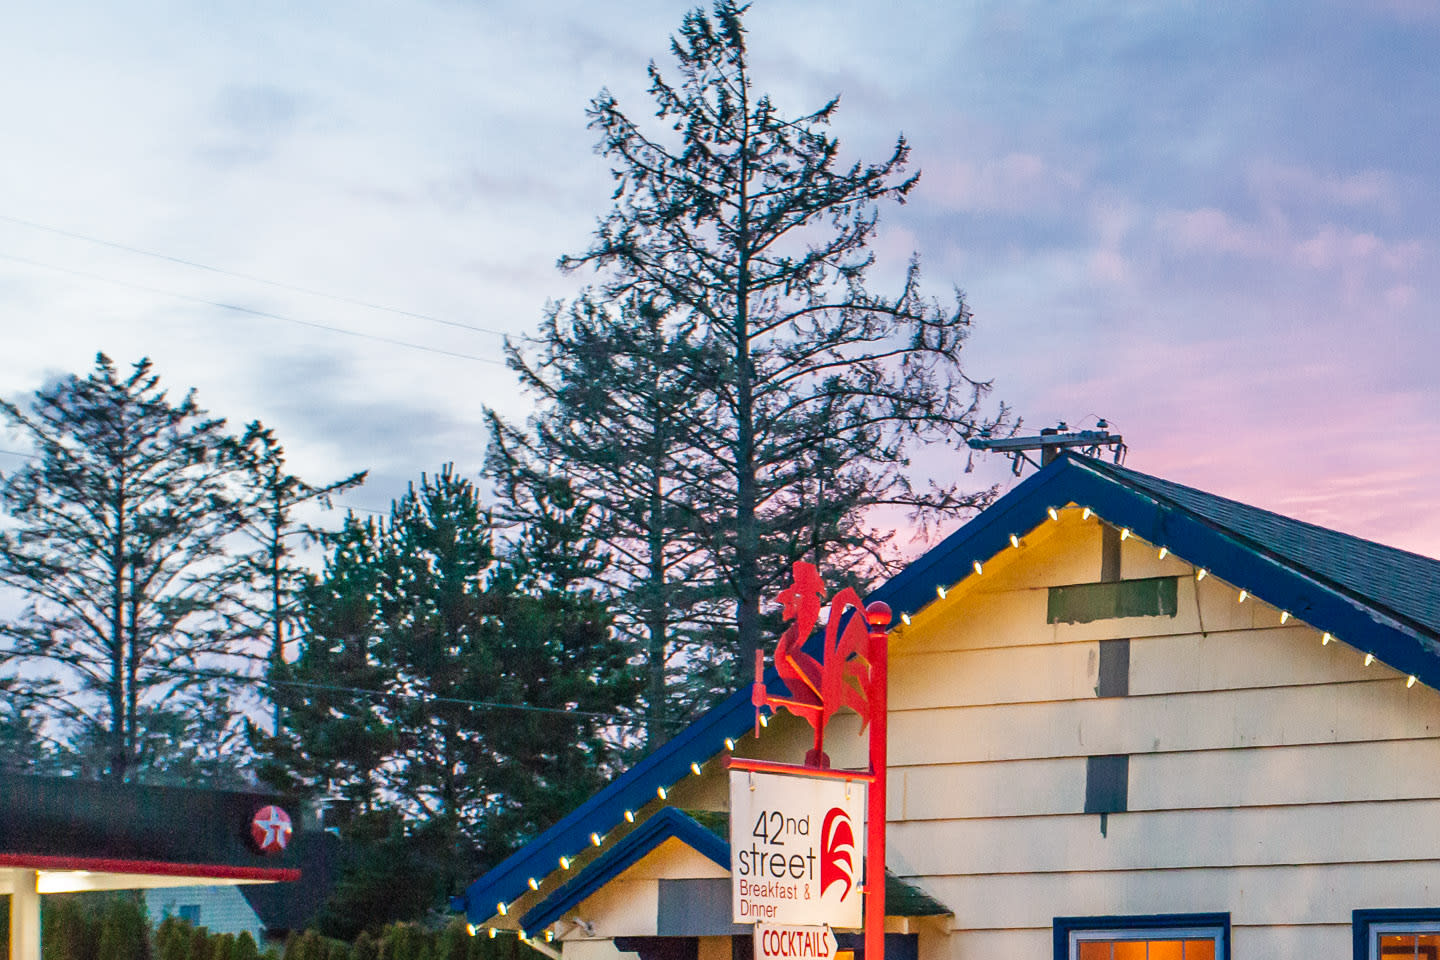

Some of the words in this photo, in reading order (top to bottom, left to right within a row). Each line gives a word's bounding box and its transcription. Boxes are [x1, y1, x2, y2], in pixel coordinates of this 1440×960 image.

[752, 810, 810, 846] 42nd
[739, 842, 817, 881] street
[739, 879, 798, 900] Breakfast
[803, 883, 811, 900] &
[740, 899, 778, 919] Dinner
[762, 929, 829, 958] COCKTAILS
